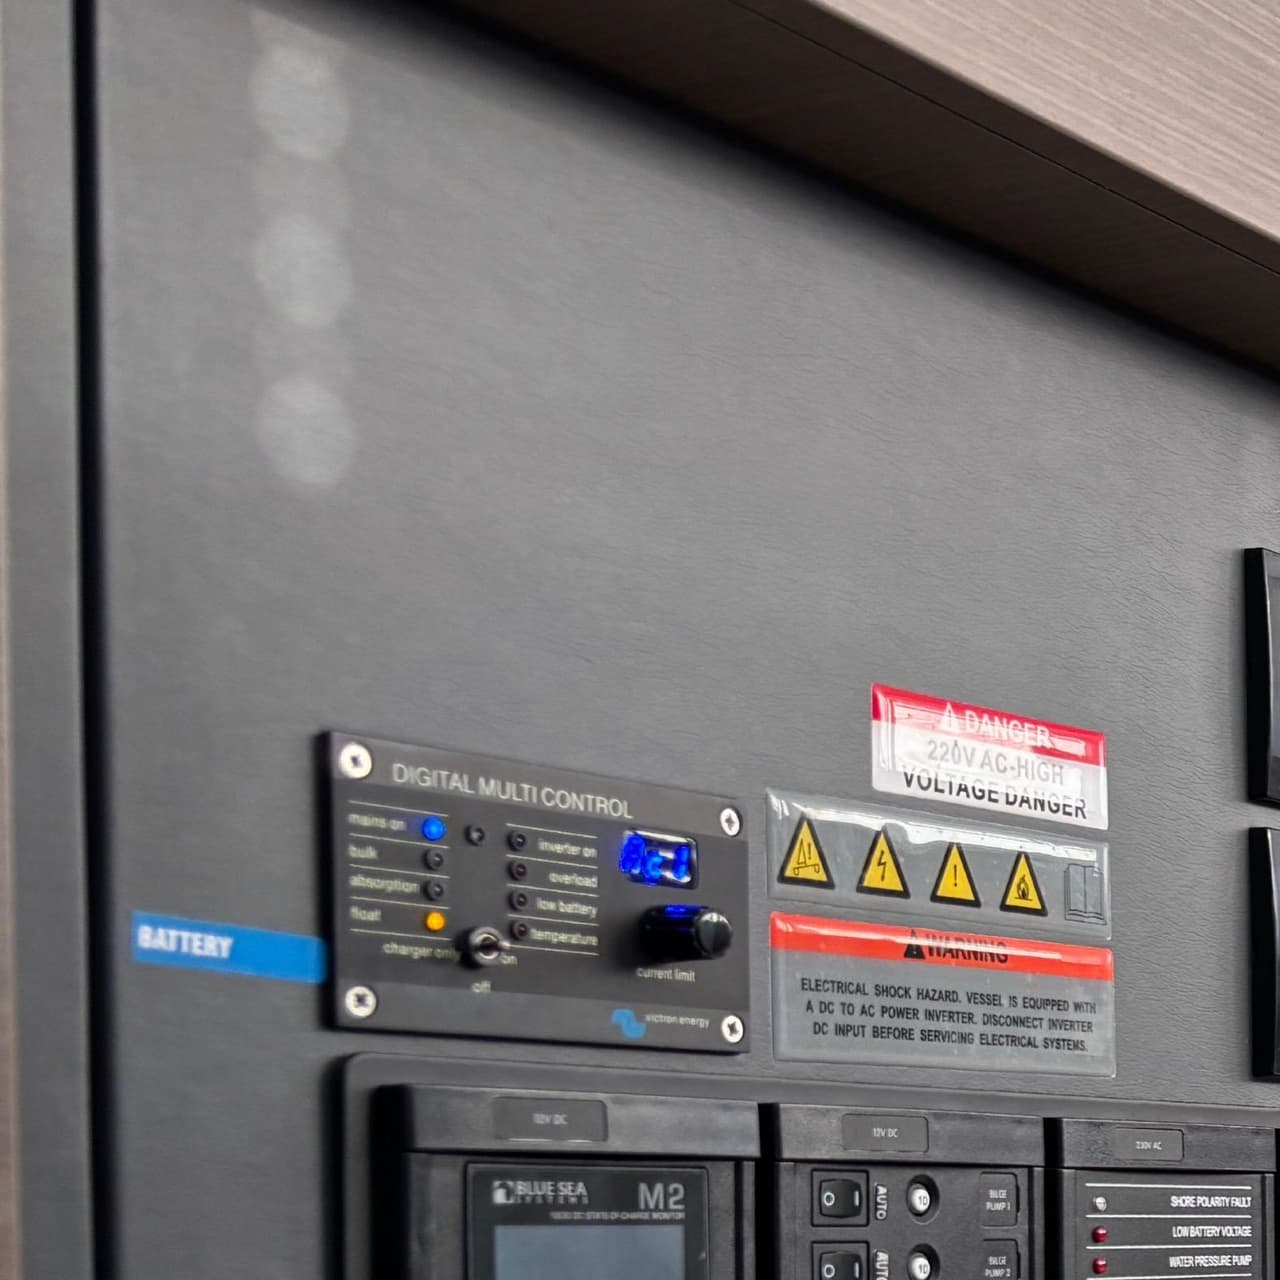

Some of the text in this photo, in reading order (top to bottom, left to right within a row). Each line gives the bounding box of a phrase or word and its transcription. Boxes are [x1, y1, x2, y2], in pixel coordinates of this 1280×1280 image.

[965, 710, 1050, 748] DANGER
[927, 739, 1064, 786] 220V AC-HIGH
[393, 763, 633, 819] DIGITAL MULTI CONTROL
[902, 764, 1088, 819] VOLTAGE DANGER
[349, 813, 406, 831] mains on
[349, 845, 378, 859] bulk
[538, 838, 598, 858] inverter on
[351, 876, 419, 894] absorption
[549, 871, 598, 888] overload
[351, 907, 382, 922] float
[536, 898, 598, 918] low battery
[137, 924, 234, 958] BATTERY
[531, 928, 598, 945] temperature
[926, 934, 1009, 964] WARNING
[636, 967, 696, 982] current limit
[472, 980, 492, 993] off
[801, 977, 1097, 1014] ELECTRICAL SHOCK HAZARD. VESSEL IS EQUIPPED WITH
[819, 1002, 835, 1015] DC
[841, 1003, 855, 1016] TO
[860, 1004, 875, 1017] AC
[881, 1006, 919, 1021] POWER
[982, 1013, 1044, 1030] DISCONNECT
[1048, 1016, 1093, 1033] INVERTER
[813, 1021, 1088, 1052] DC INPUT BEFORE SERVICING ELECTRICAL SYSTEMS.
[872, 1127, 898, 1139] 12V DC
[516, 1180, 588, 1196] BLUE SEA
[989, 1189, 1007, 1200] BILGE
[875, 1182, 888, 1221] AUTO
[918, 1196, 929, 1207] 10
[986, 1201, 1006, 1212] PUMP
[1170, 1196, 1252, 1208] SHORE POLARITY FAULT
[1172, 1226, 1252, 1237] LOW BATTERY VOLTAGE
[918, 1264, 929, 1275] 10
[988, 1256, 1007, 1266] BILGE
[1169, 1255, 1252, 1268] WATER PRESSURE PUMP
[985, 1268, 1005, 1279] PUMP
